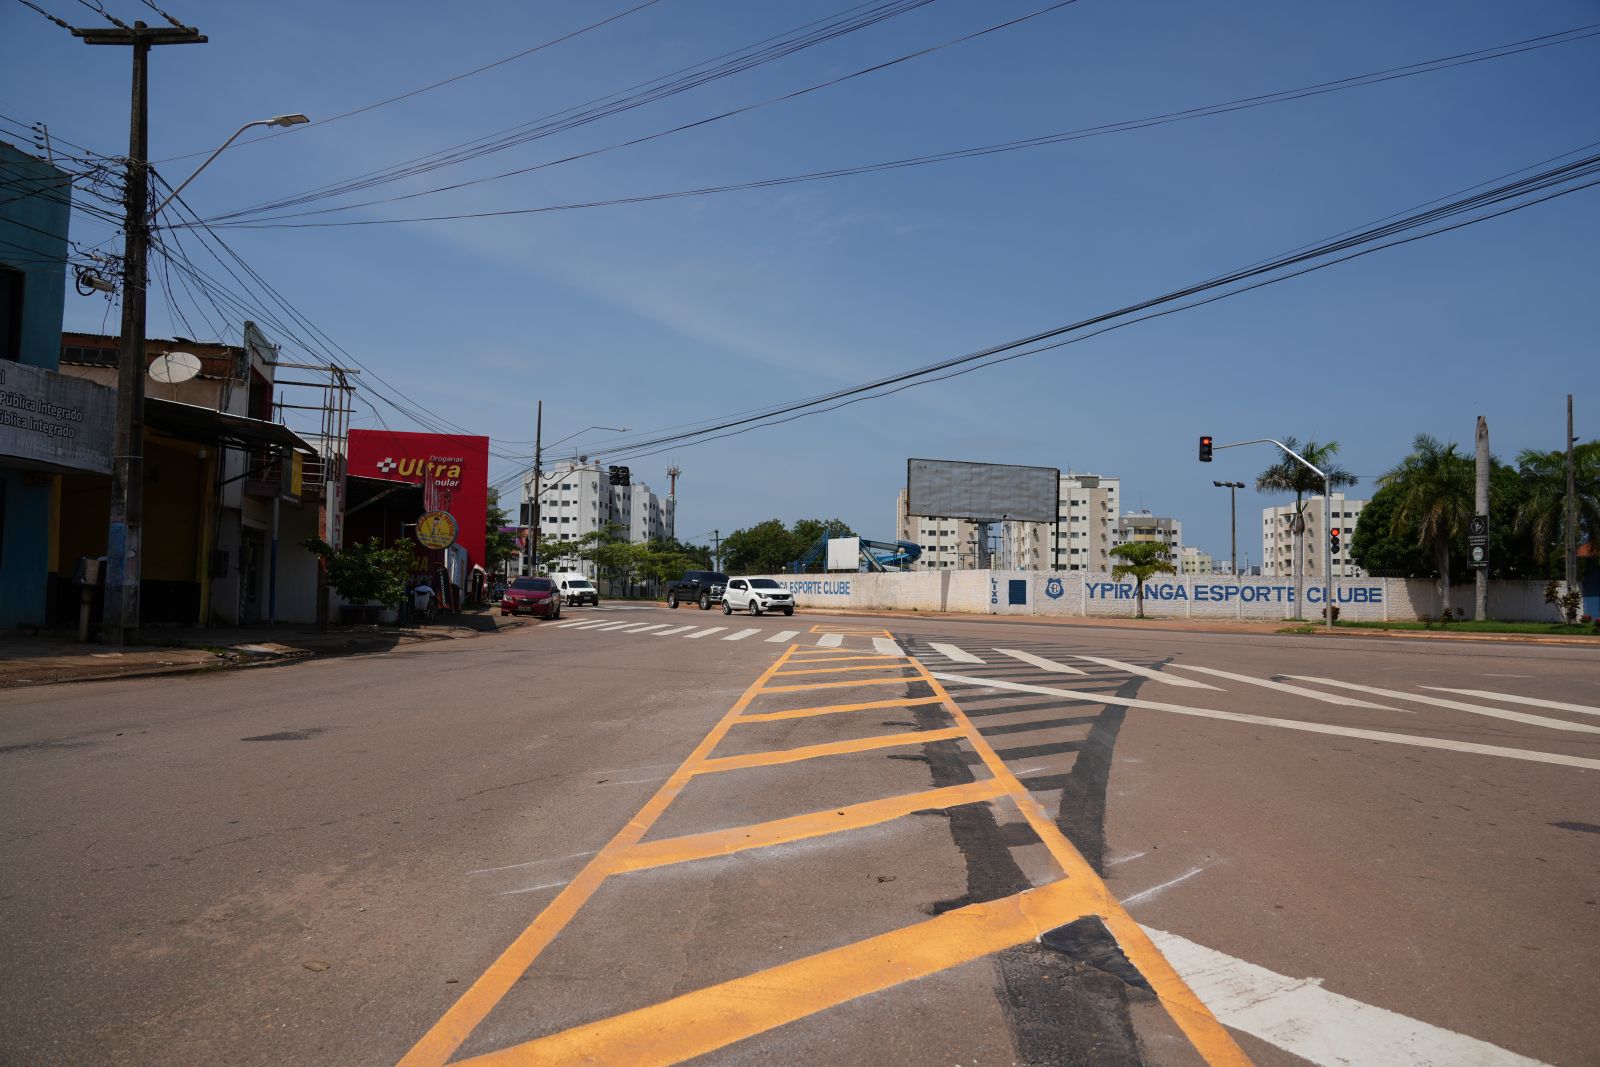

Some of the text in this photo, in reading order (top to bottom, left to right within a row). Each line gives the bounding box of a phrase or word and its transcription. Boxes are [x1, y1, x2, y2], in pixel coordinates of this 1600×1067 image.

[38, 400, 83, 422] Integrado
[30, 417, 75, 438] Integrado
[398, 458, 461, 478] Ultra
[789, 581, 822, 594] ESPORTE
[823, 581, 850, 595] CLUBE
[1085, 583, 1382, 603] YPIRANGA ESPORTE CLUBE
